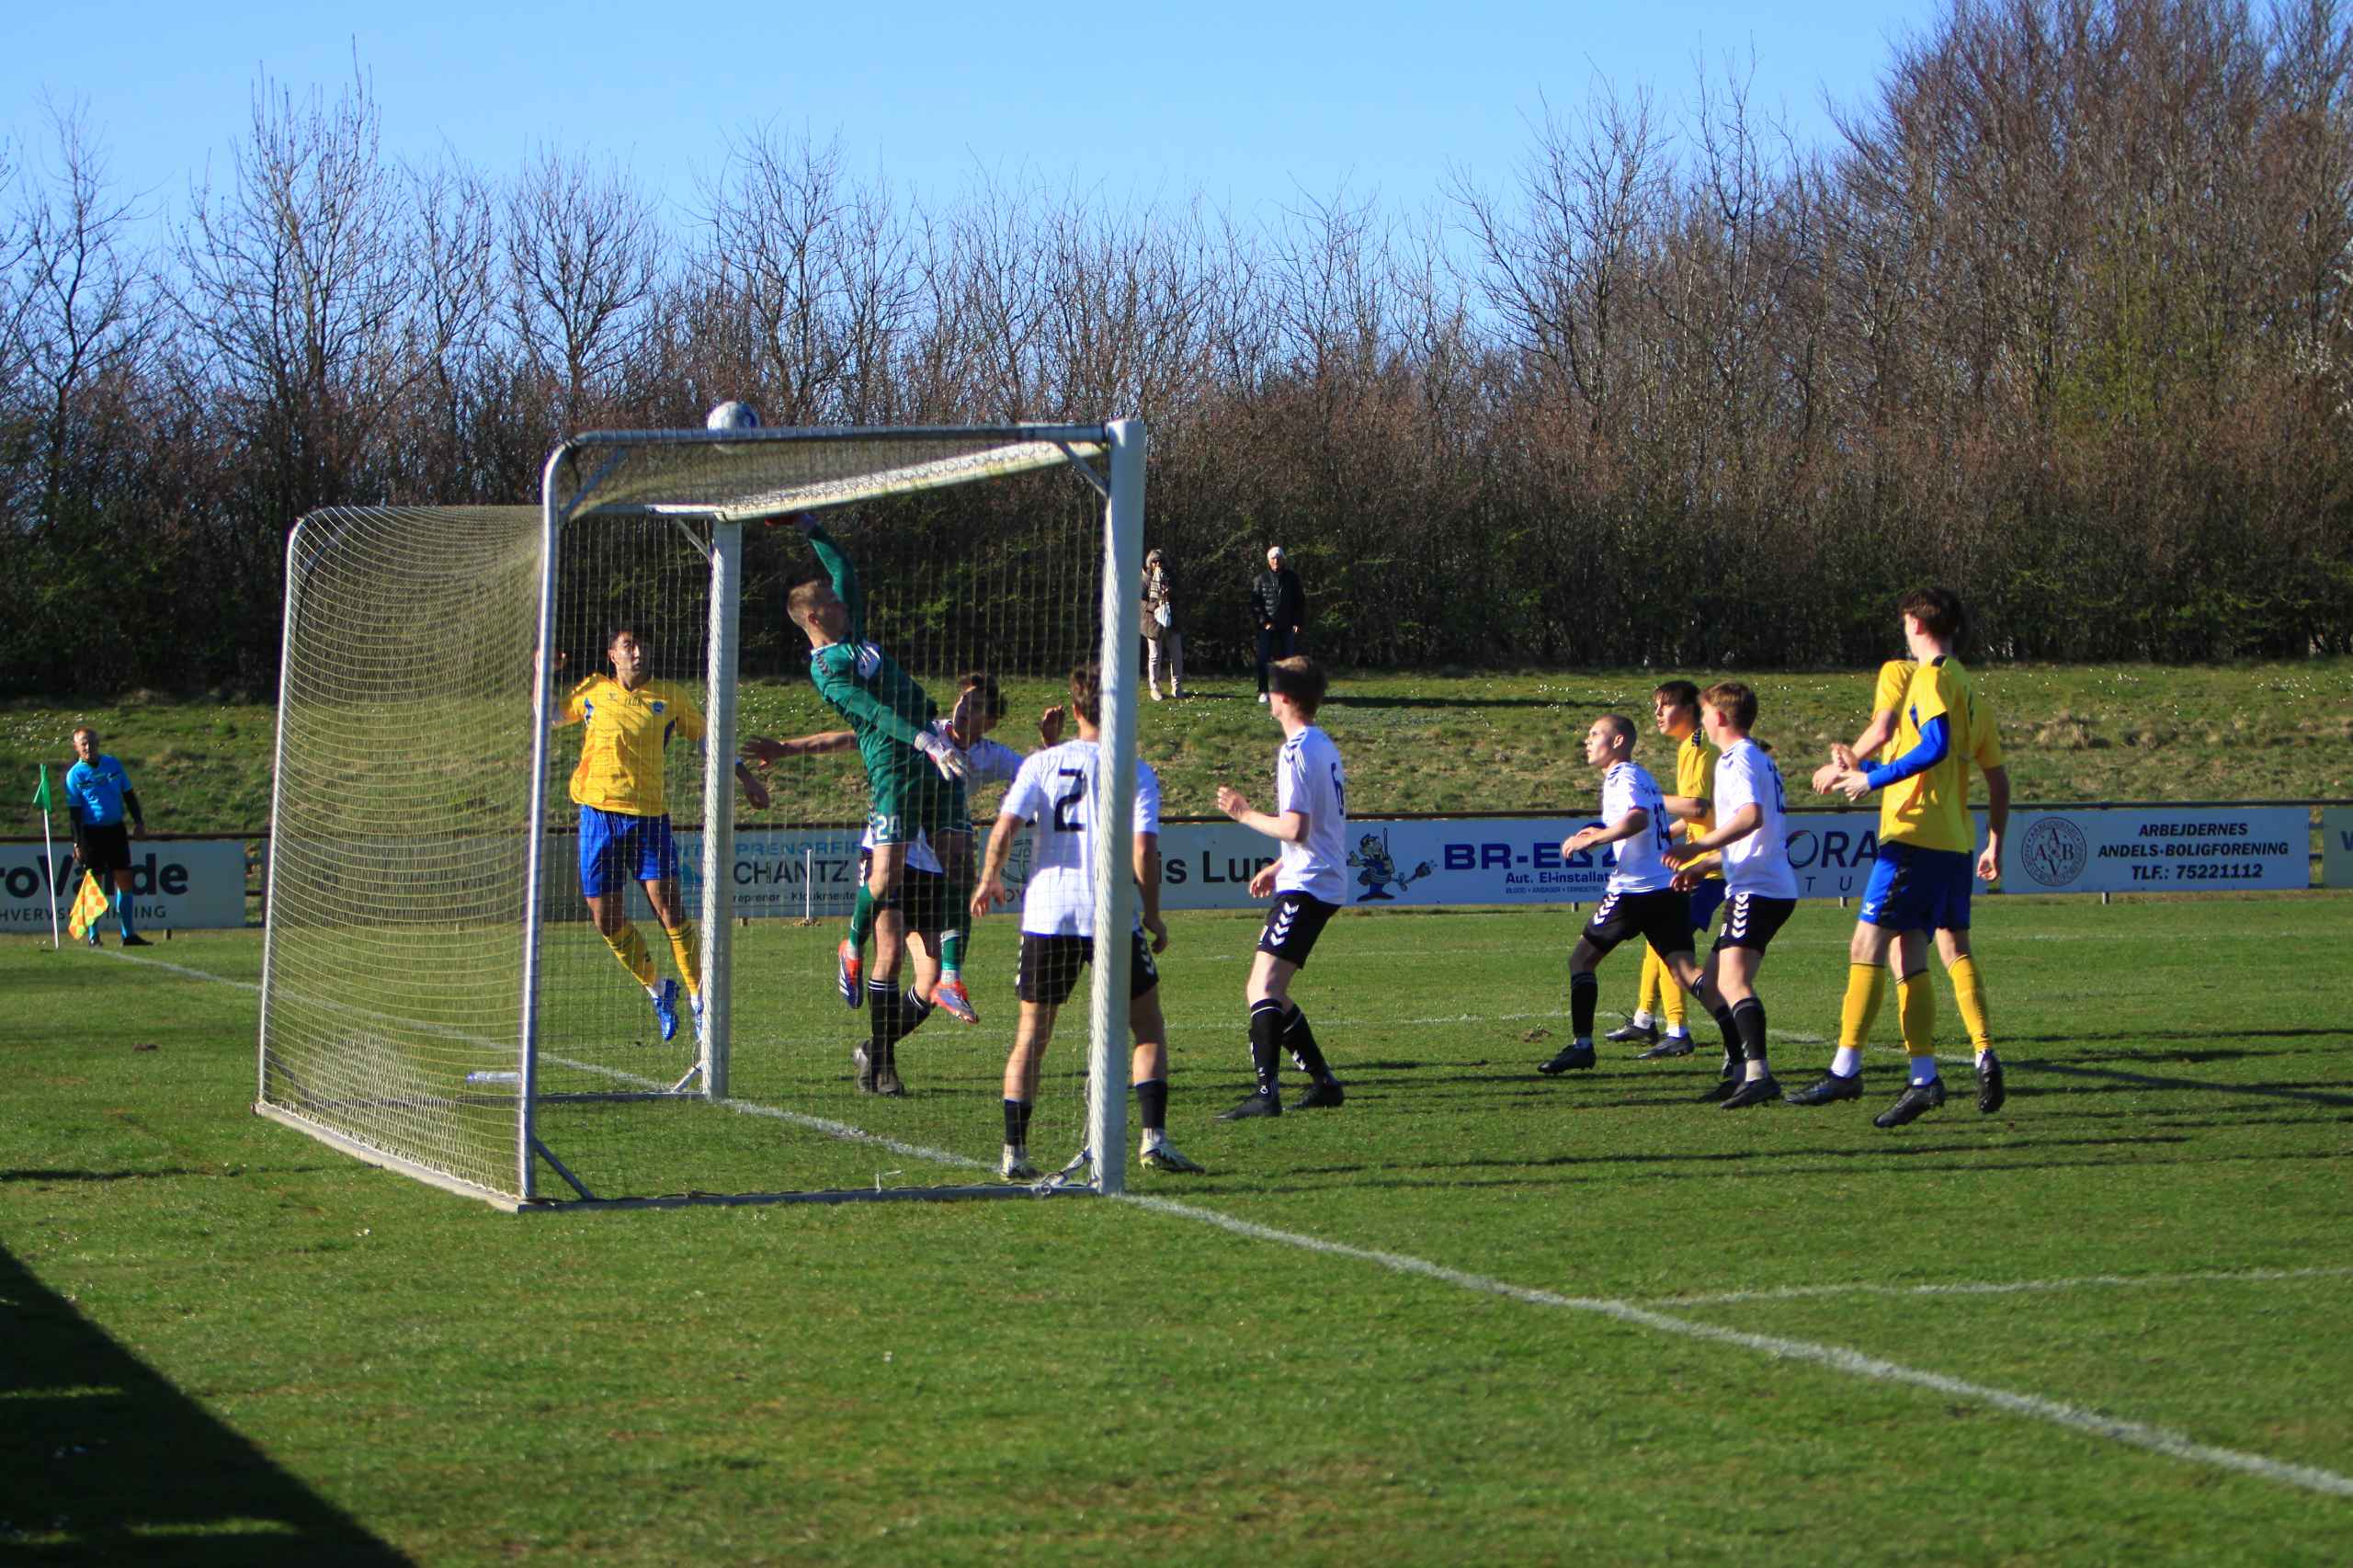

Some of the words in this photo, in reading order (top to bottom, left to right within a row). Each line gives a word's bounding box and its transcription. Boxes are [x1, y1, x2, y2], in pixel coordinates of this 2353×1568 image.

[1053, 768, 1088, 833] 2
[875, 815, 901, 840] 24
[2139, 823, 2248, 837] ARBEJDERNES
[2097, 842, 2290, 858] ANDELS-BOLIGFORENING
[1506, 872, 1534, 884] Aut.
[2132, 865, 2169, 880] TLF.:
[2176, 863, 2263, 880] 75221112
